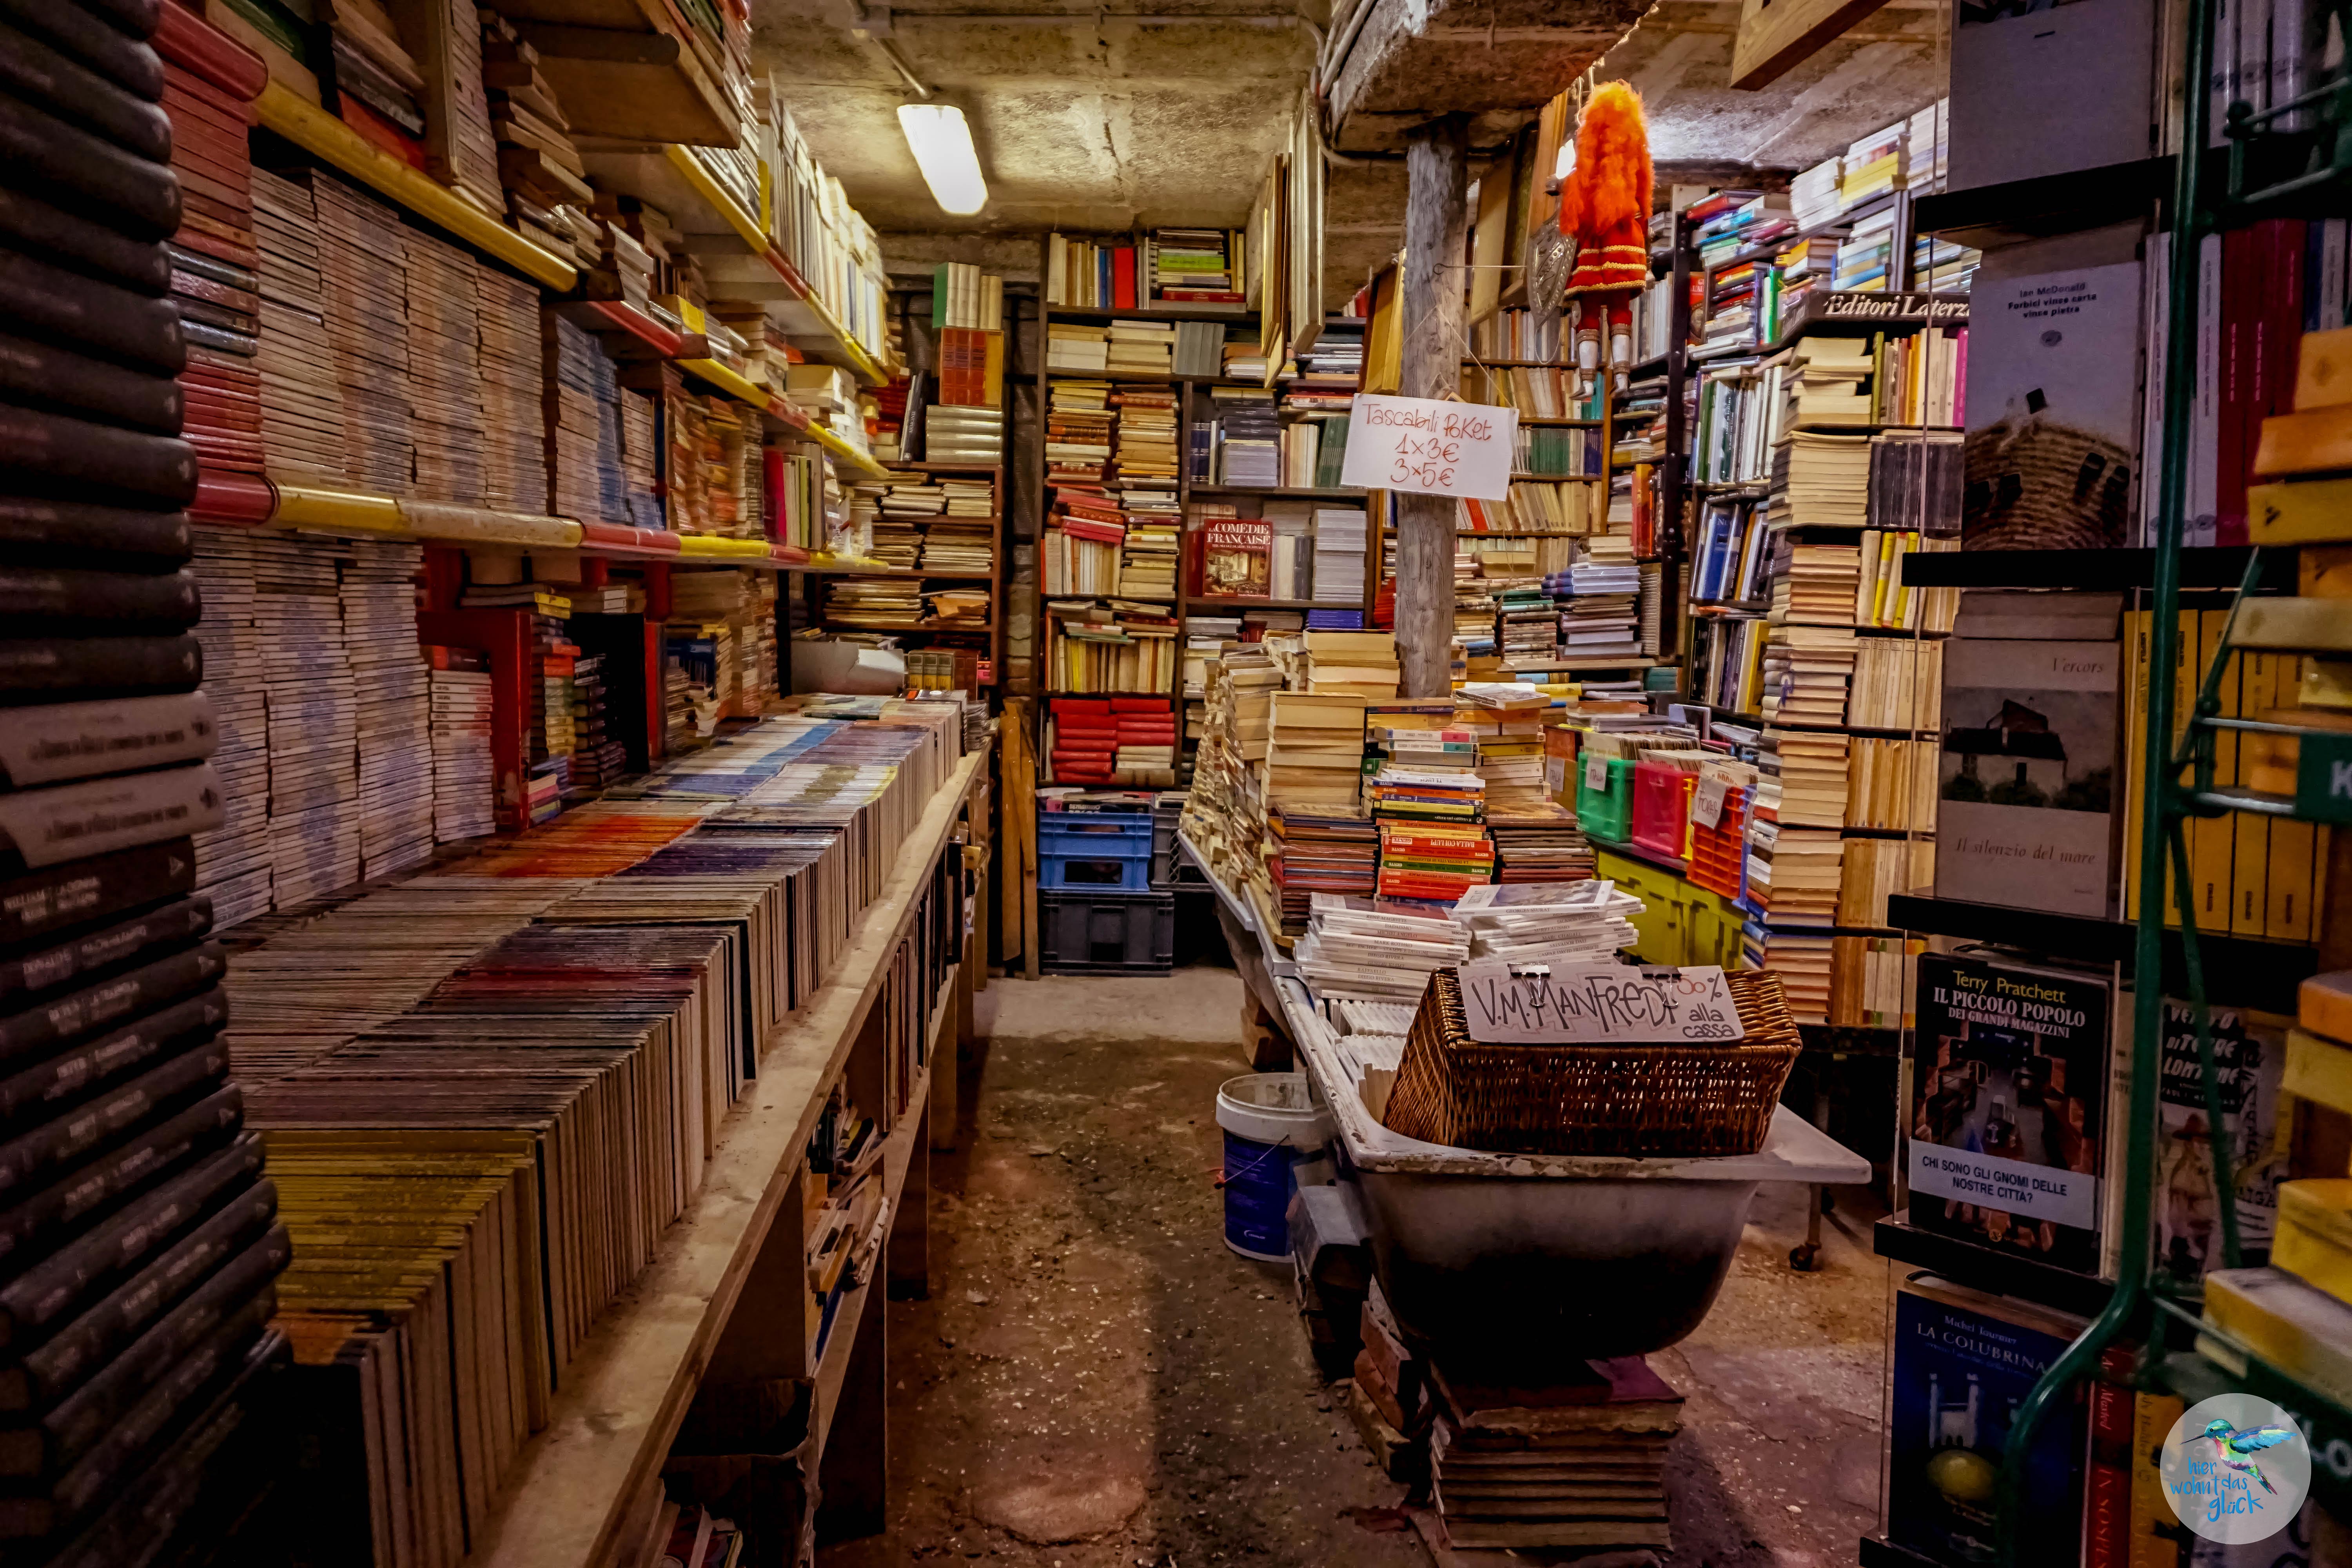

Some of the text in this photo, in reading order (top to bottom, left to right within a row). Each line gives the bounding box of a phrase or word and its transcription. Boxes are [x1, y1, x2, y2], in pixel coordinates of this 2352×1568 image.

[2037, 282, 2085, 295] McDonald
[1824, 293, 1900, 315] Editori
[2008, 294, 2096, 310] Forbici vince carta
[2051, 307, 2080, 316] pietra
[1363, 404, 1439, 432] Tascabili
[1215, 523, 1269, 534] COMÉDIE
[1207, 533, 1271, 545] FRANÇAISE
[2053, 657, 2103, 675] Vercors
[1957, 837, 2095, 864] Il silenzio del mare
[1377, 929, 1418, 938] MICHELANGELO
[1952, 970, 2066, 1004] Terry Pratchett
[1689, 1003, 1724, 1022] alla
[1933, 986, 2086, 1028] IL PICCOLO POPOLO
[1682, 1024, 1736, 1039] cassa
[1948, 1006, 2070, 1039] DEI GRANDI MAGAZZINI
[1922, 1156, 2067, 1196] CHI SONO GLI GNOMI DELLE
[1953, 1176, 1994, 1195] NOSTRE
[1917, 1322, 1936, 1339] LA
[1942, 1331, 2047, 1375] COLUBRINA
